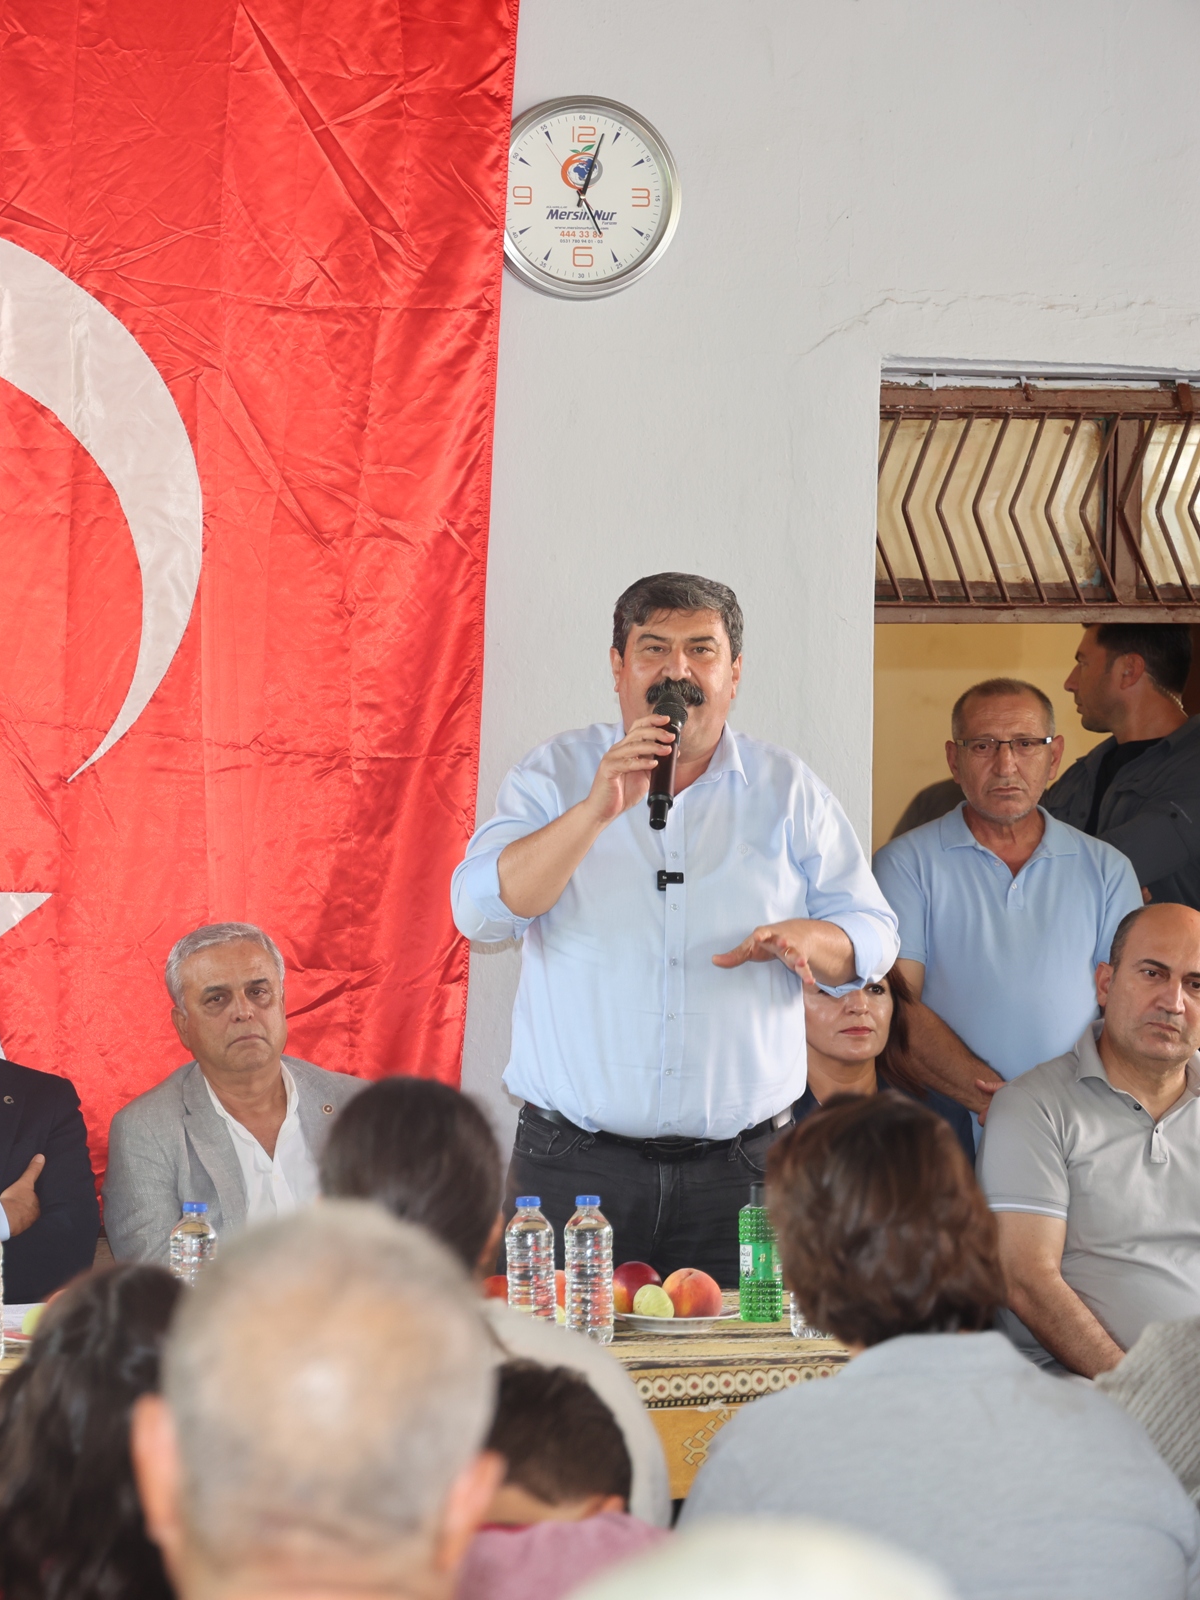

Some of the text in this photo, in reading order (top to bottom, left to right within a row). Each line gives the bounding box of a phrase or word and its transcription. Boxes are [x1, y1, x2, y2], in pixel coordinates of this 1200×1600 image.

[572, 126, 596, 143] 12
[512, 152, 519, 160] 50
[645, 155, 651, 163] 10
[512, 186, 532, 205] 9
[631, 187, 650, 207] 3
[655, 194, 661, 202] 15
[512, 231, 519, 239] 40
[559, 230, 576, 238] 444
[579, 230, 590, 238] 33
[644, 233, 651, 241] 20
[572, 246, 593, 267] 6
